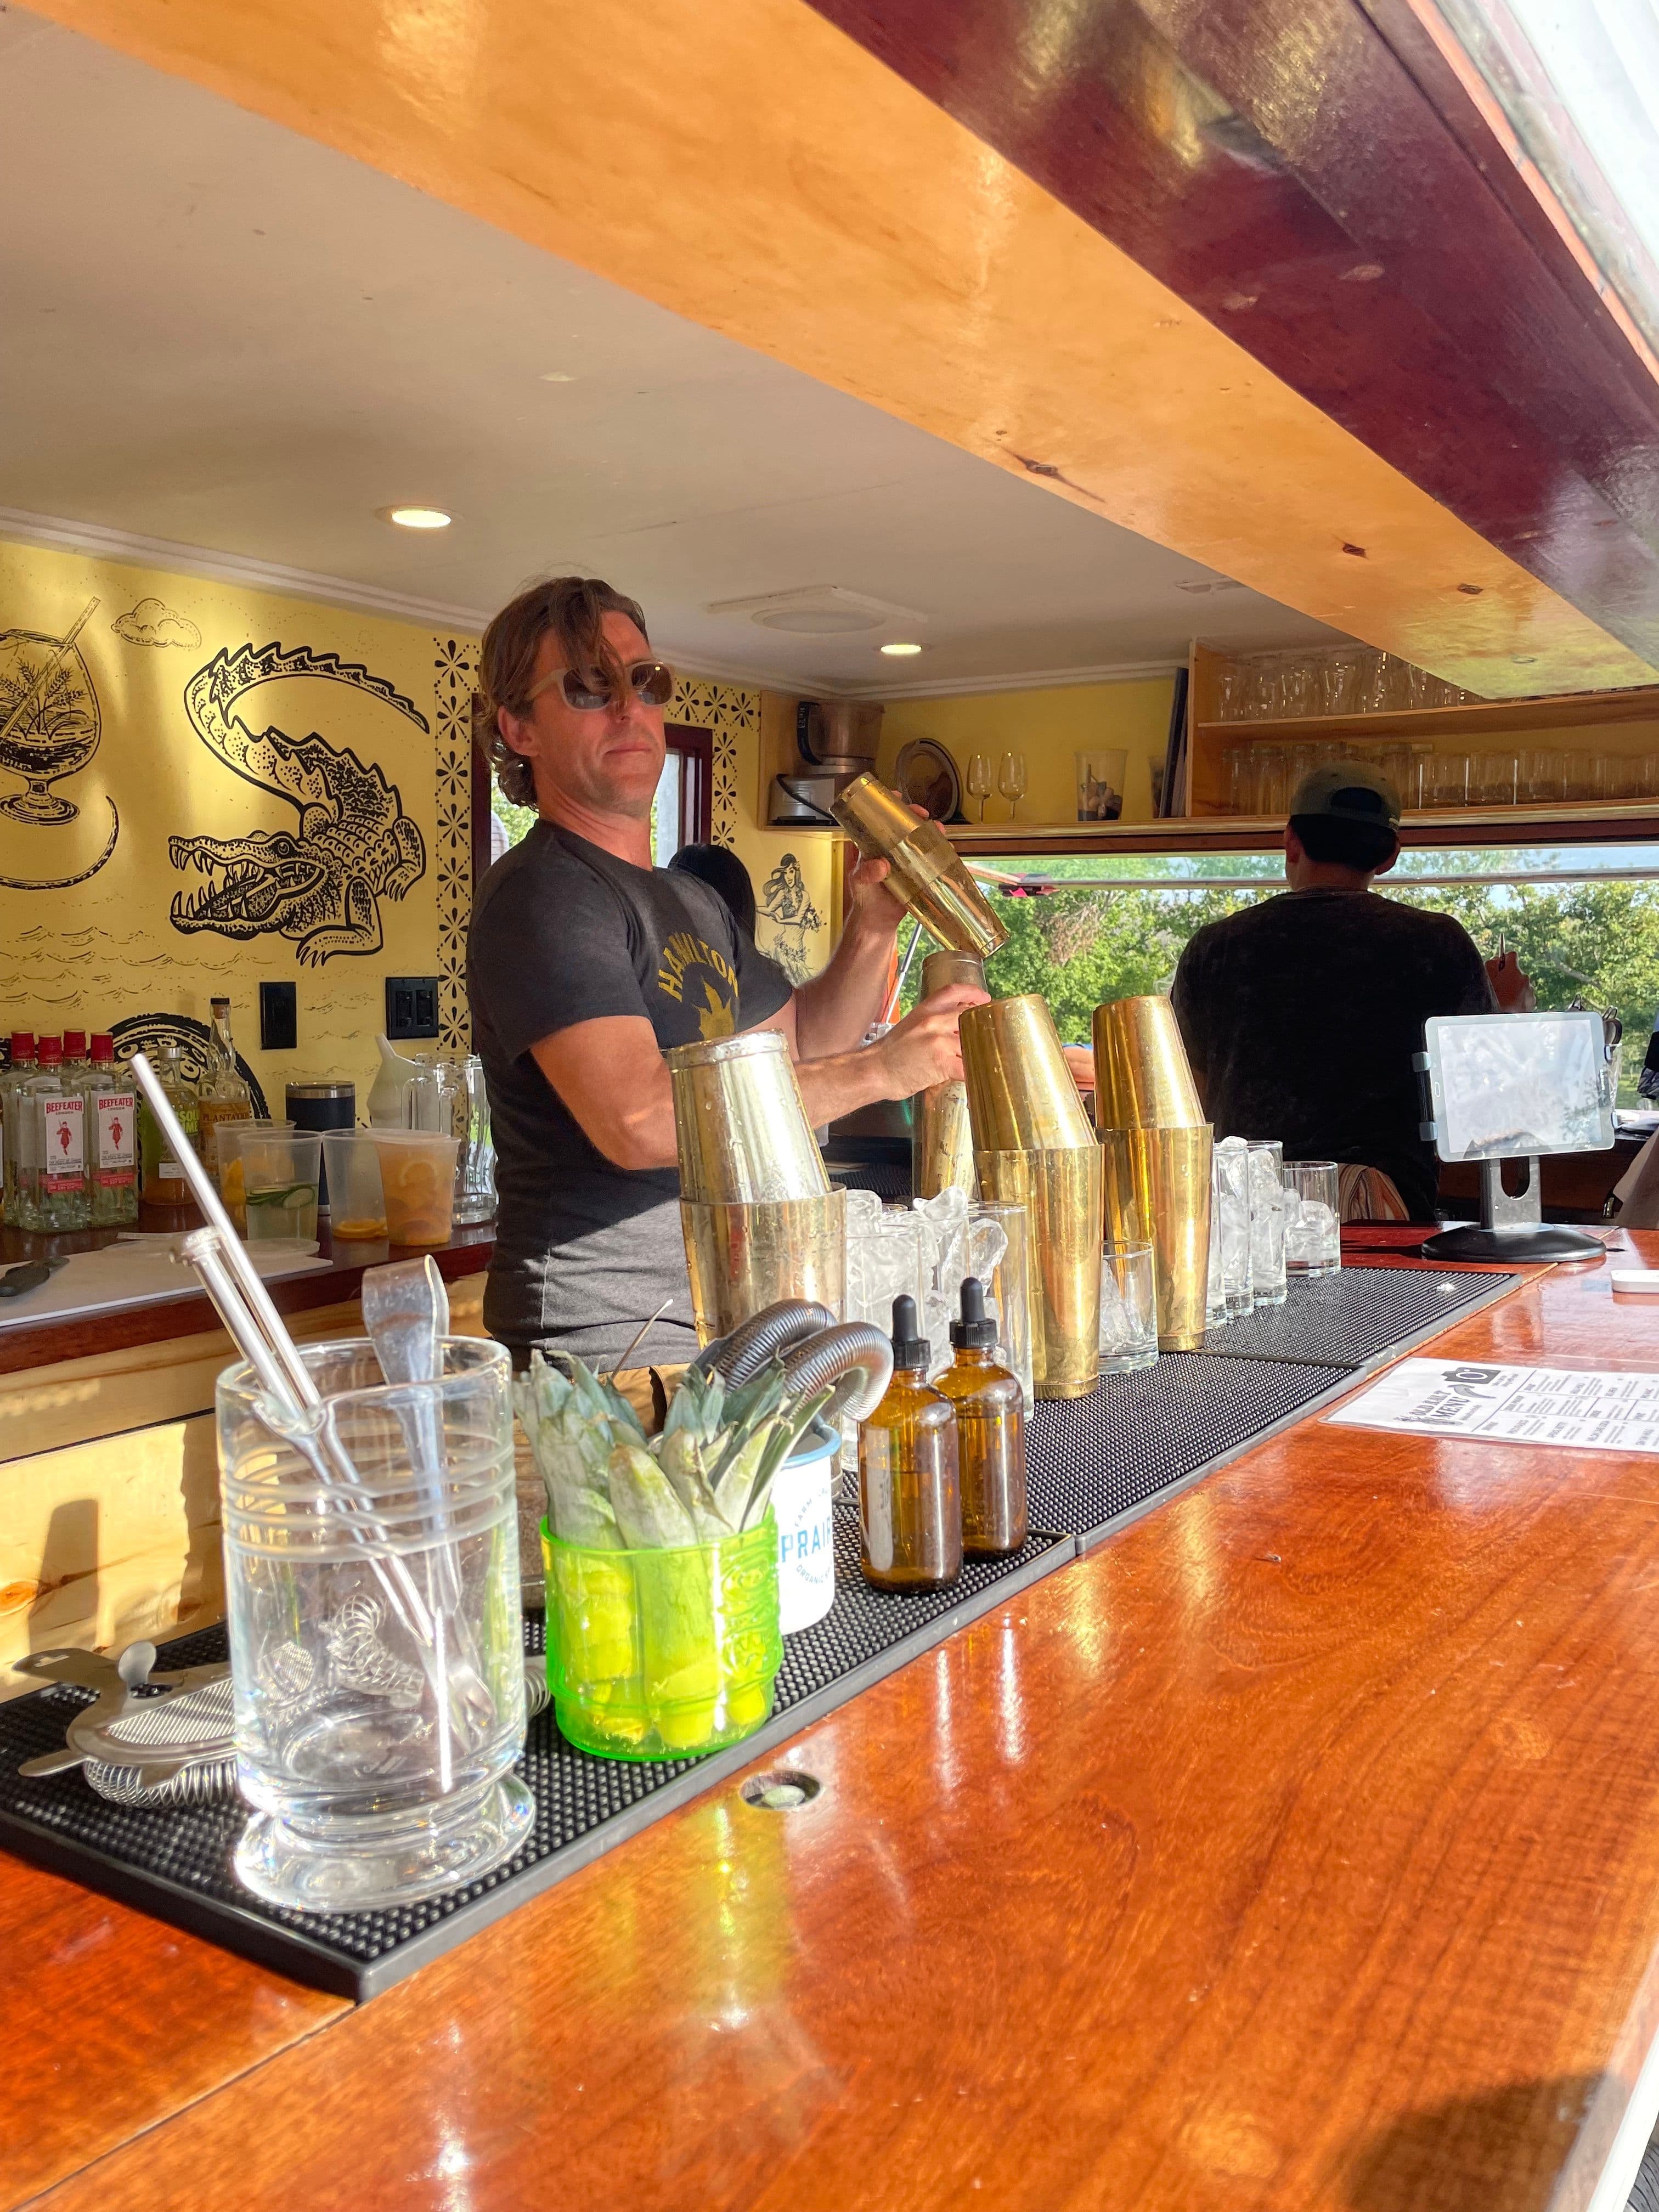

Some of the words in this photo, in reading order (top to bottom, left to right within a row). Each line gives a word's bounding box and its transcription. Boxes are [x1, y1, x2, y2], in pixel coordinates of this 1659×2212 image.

[46, 1101, 82, 1114] BEEFEATER
[99, 1097, 133, 1109] BEEFEATER
[1431, 1397, 1470, 1419] MENU
[796, 1565, 823, 1584] ORGANIC
